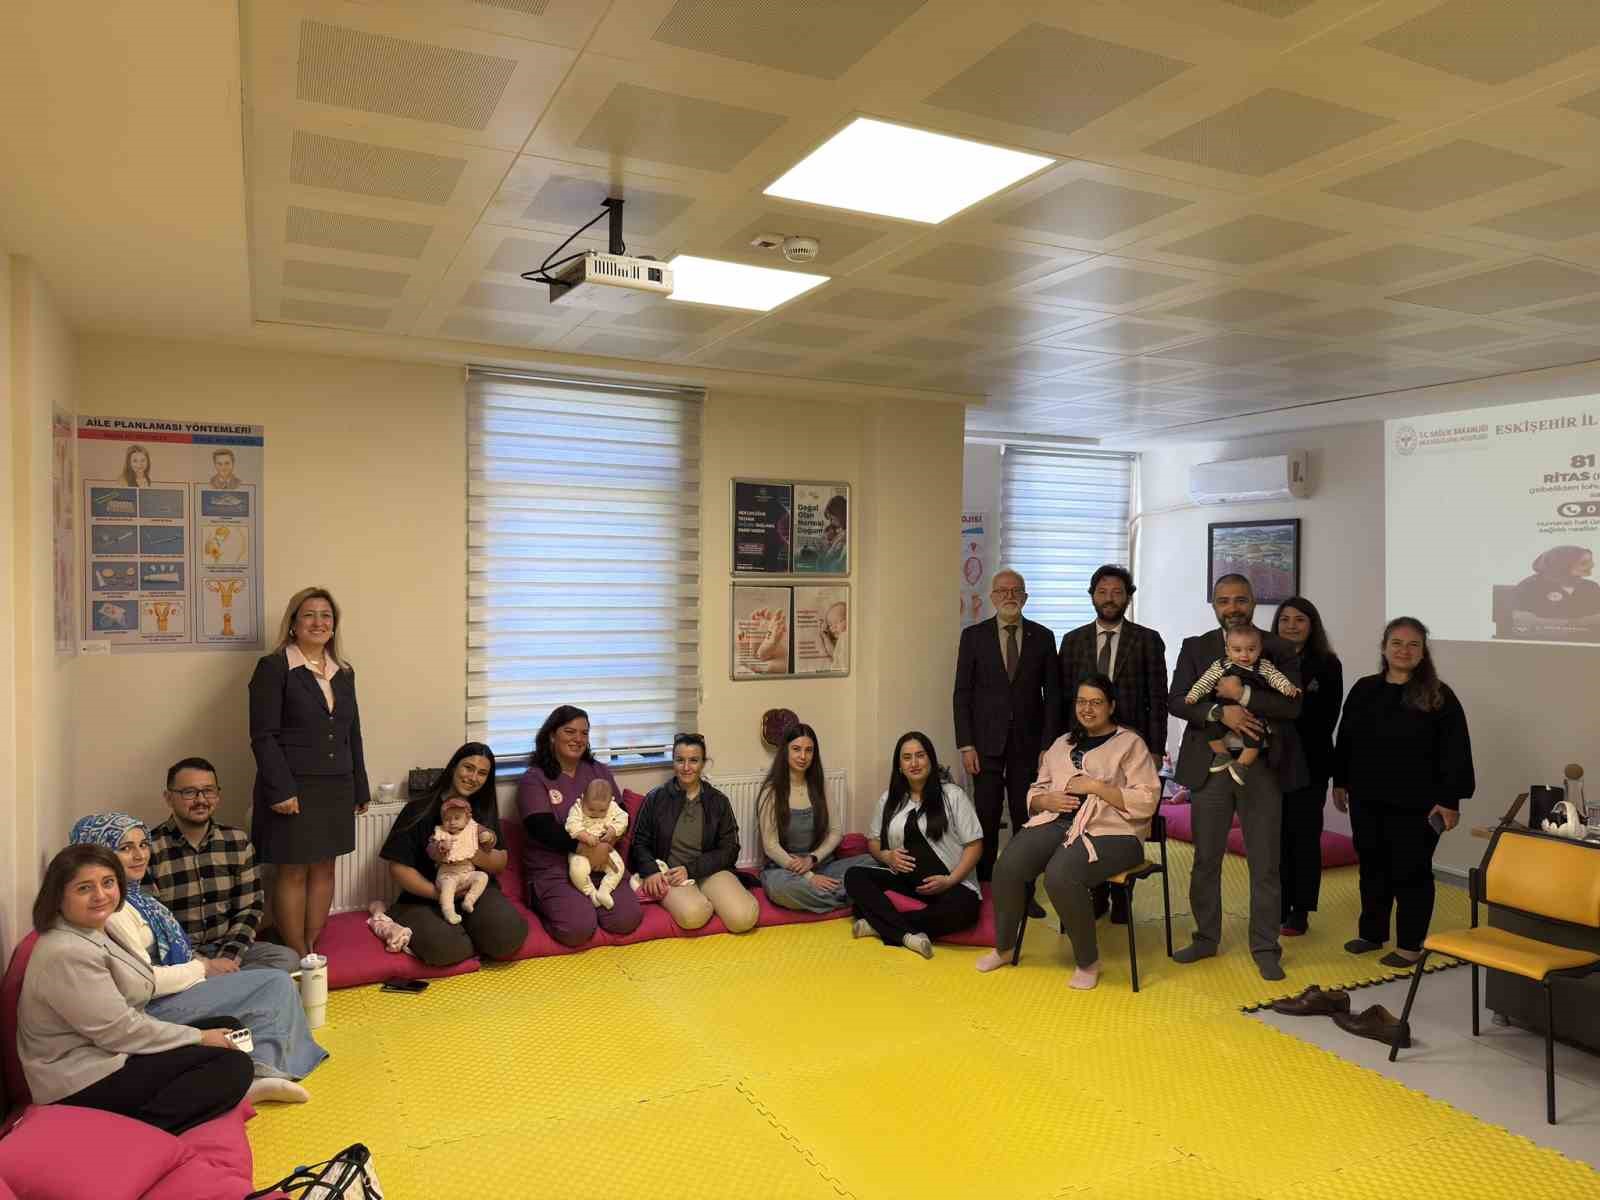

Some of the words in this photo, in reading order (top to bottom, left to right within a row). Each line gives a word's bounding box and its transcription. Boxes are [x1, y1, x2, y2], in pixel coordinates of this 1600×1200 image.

[86, 417, 112, 428] AİLE
[114, 420, 182, 432] PLANLAMASI
[185, 422, 252, 434] YÖNTEMLERİ
[1495, 415, 1577, 436] ESKİŞEHİR
[1569, 453, 1596, 469] 81
[1543, 471, 1591, 484] RİTAS
